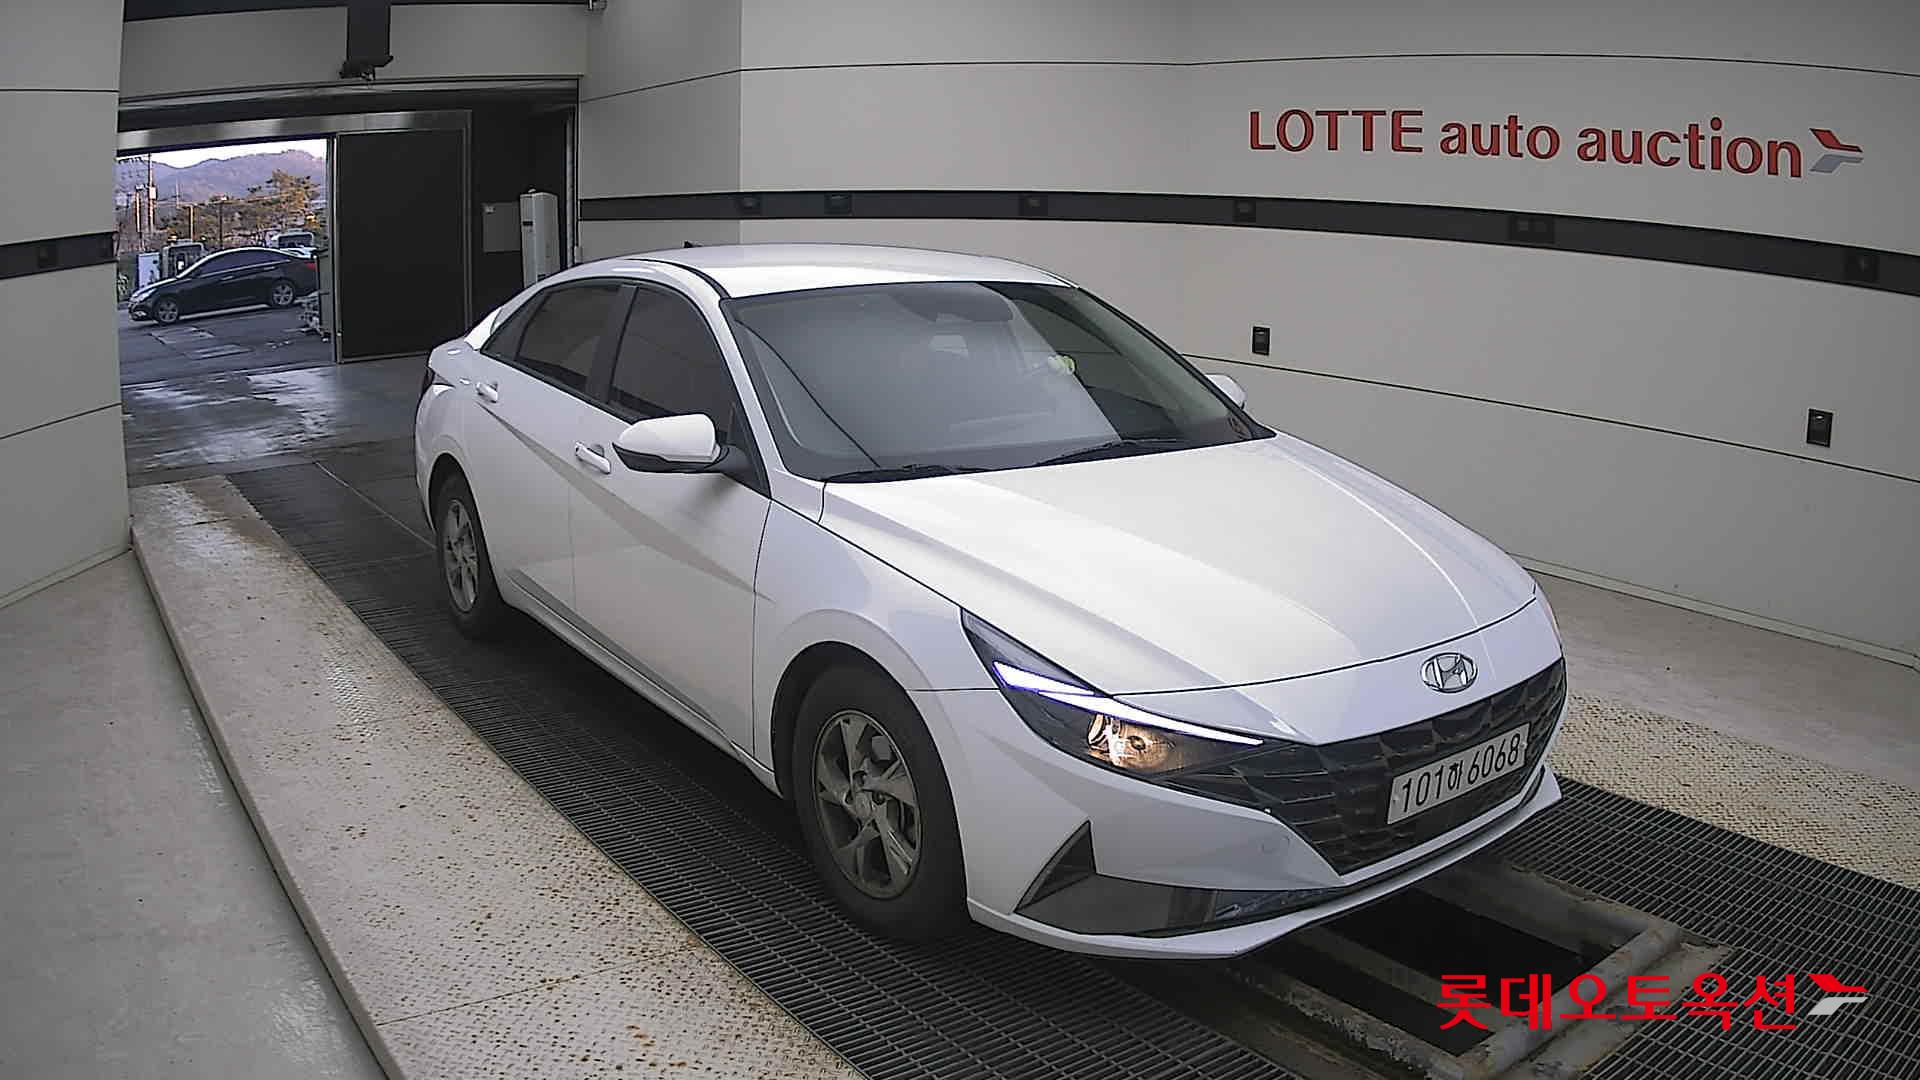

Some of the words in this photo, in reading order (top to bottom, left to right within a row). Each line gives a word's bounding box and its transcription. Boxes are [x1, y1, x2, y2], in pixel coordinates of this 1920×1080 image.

[1249, 110, 1424, 153] LOTTE
[1439, 114, 1561, 160] auto
[1576, 117, 1803, 178] auction
[1467, 732, 1522, 785] 6068
